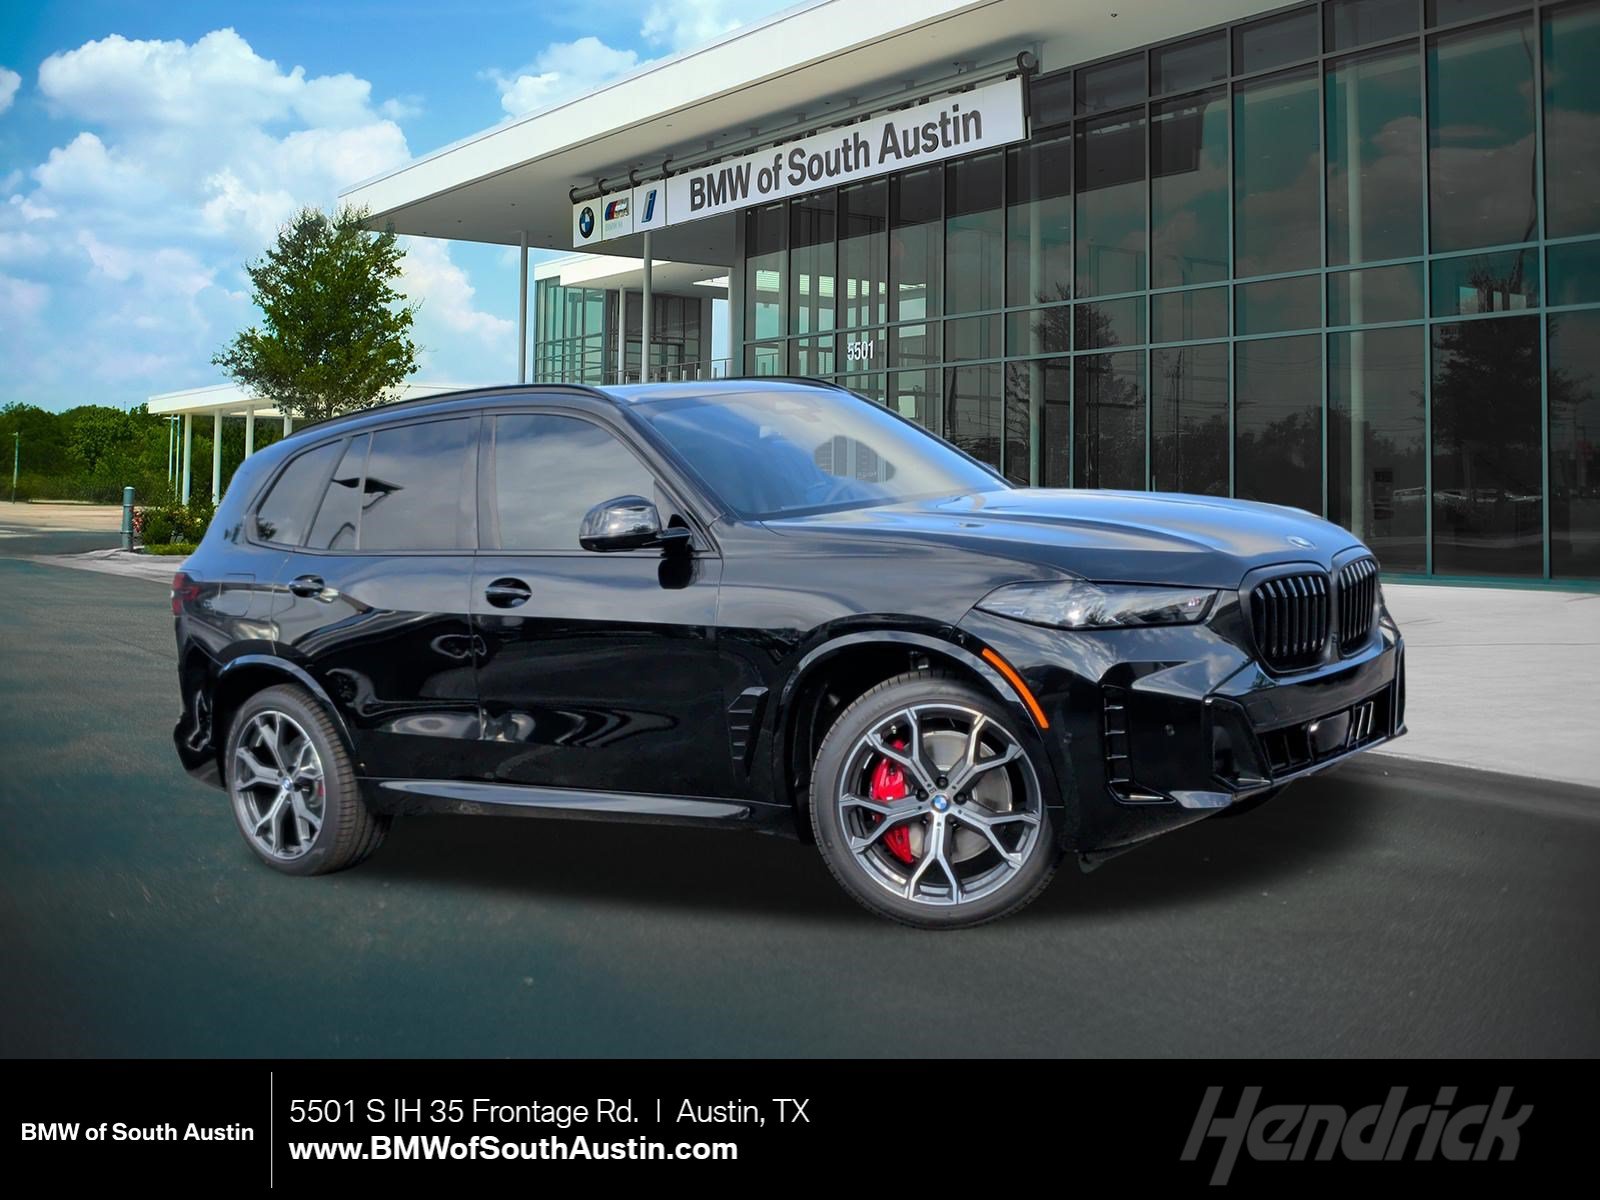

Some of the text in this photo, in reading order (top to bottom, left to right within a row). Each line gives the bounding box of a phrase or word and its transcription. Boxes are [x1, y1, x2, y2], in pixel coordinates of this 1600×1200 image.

[690, 162, 751, 212] BMW
[757, 153, 782, 194] of
[787, 132, 870, 186] South
[878, 103, 982, 164] Austin
[847, 340, 874, 361] 5501
